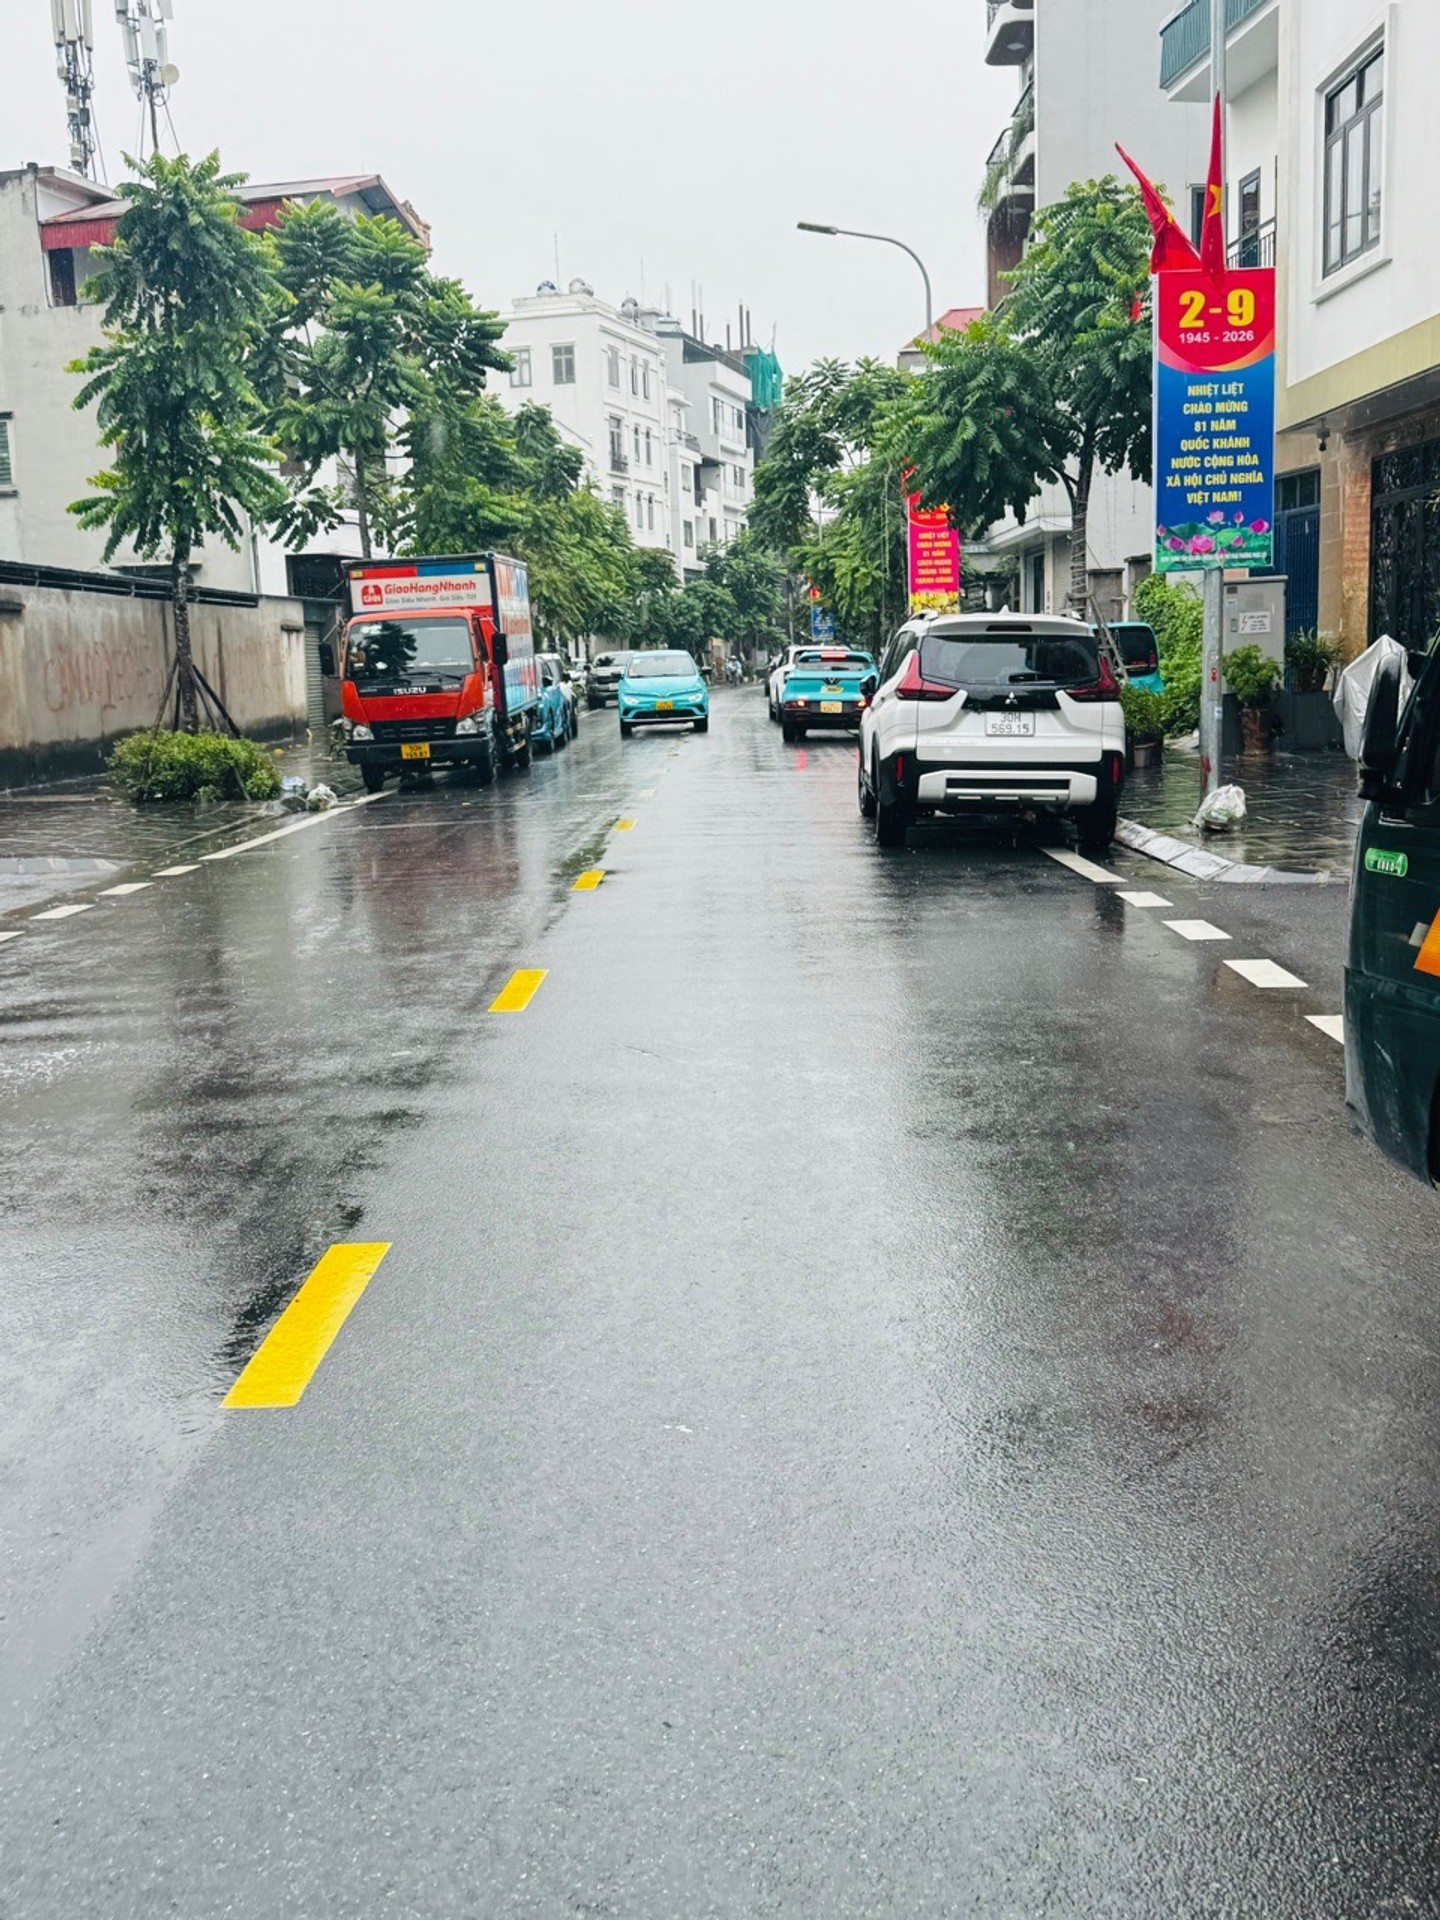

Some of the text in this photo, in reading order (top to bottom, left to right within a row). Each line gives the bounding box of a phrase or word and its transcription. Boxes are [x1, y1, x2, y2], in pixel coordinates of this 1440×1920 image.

[1178, 287, 1256, 328] 2-9
[1178, 332, 1211, 344] 1945
[1222, 330, 1255, 343] 2026
[1187, 381, 1245, 397] NHIỆT LIỆT
[1183, 400, 1248, 415] CHÀO MỪNG
[1194, 418, 1236, 432] 81 NĂM
[1180, 435, 1250, 452] QUỐC KHÁNH
[1171, 452, 1259, 469] NƯỚC CỘNG HÒA
[1166, 470, 1264, 488] XÃ HỘI CHỦ NGHĨA
[1186, 491, 1242, 506] VIỆT NAM!
[384, 579, 476, 595] GiaoHangNhanh
[393, 686, 427, 695] ISUZU
